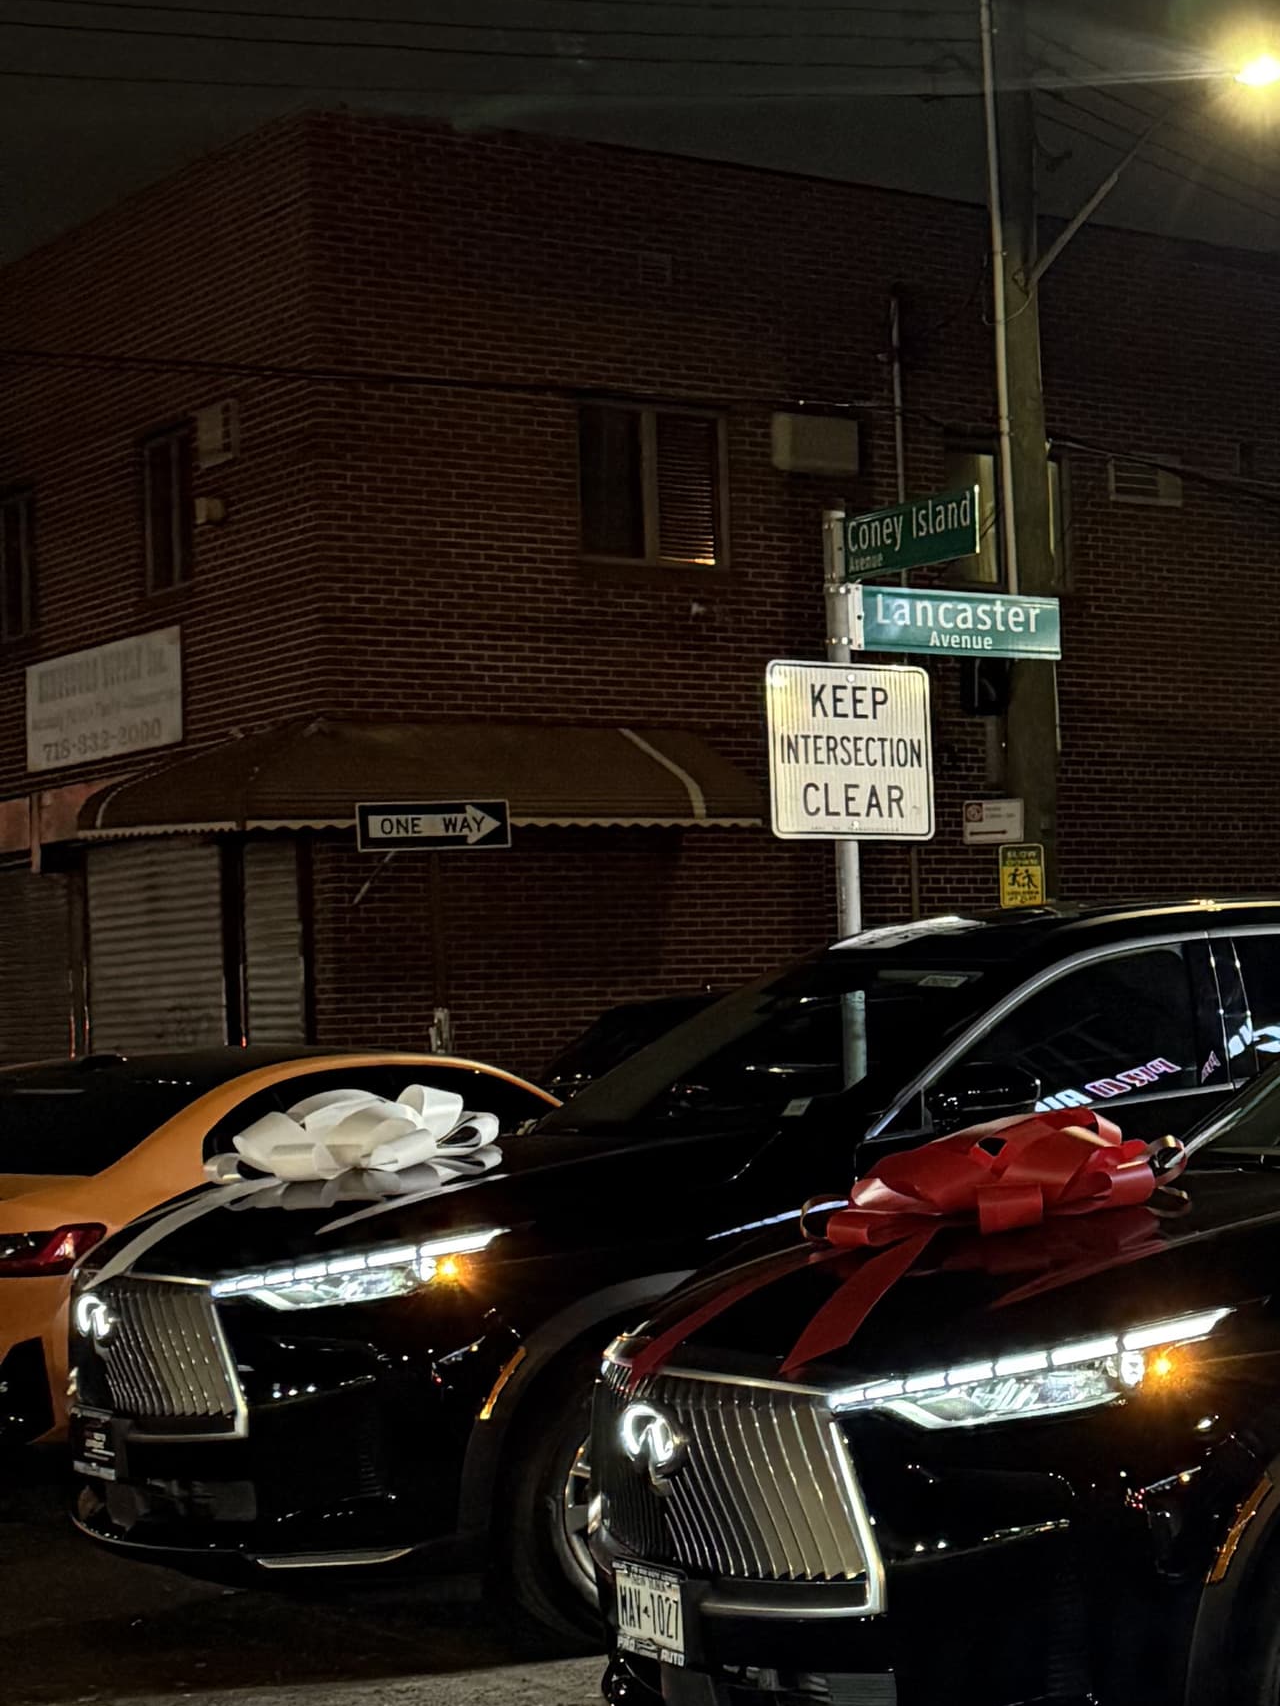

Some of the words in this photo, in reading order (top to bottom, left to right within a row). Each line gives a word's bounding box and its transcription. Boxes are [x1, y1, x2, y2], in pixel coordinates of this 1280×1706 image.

[847, 514, 904, 553] Coney
[911, 490, 972, 539] Island
[849, 553, 884, 574] Avenue
[875, 593, 1041, 633] Lancaster
[929, 630, 993, 650] Avenue
[810, 683, 889, 720] KEEP
[780, 732, 923, 769] INTERSECTION
[803, 782, 905, 819] CLEAR
[380, 817, 422, 835] ONE
[442, 815, 486, 834] WAY
